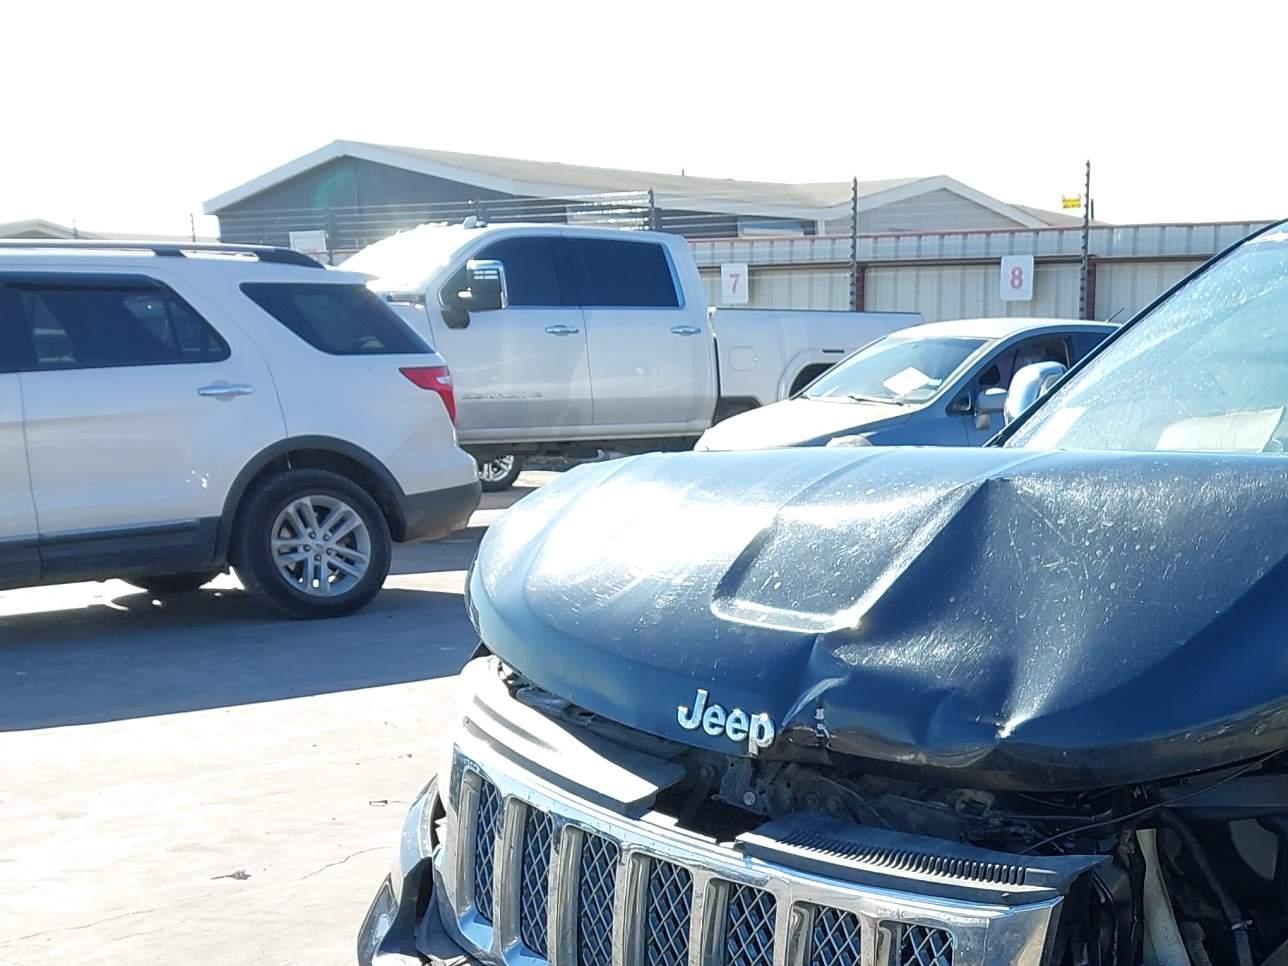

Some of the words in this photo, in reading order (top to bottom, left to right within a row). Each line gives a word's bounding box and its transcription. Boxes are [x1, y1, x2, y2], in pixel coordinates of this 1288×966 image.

[729, 273, 740, 294] 7
[1010, 266, 1023, 289] 8
[677, 688, 775, 756] Jeep
